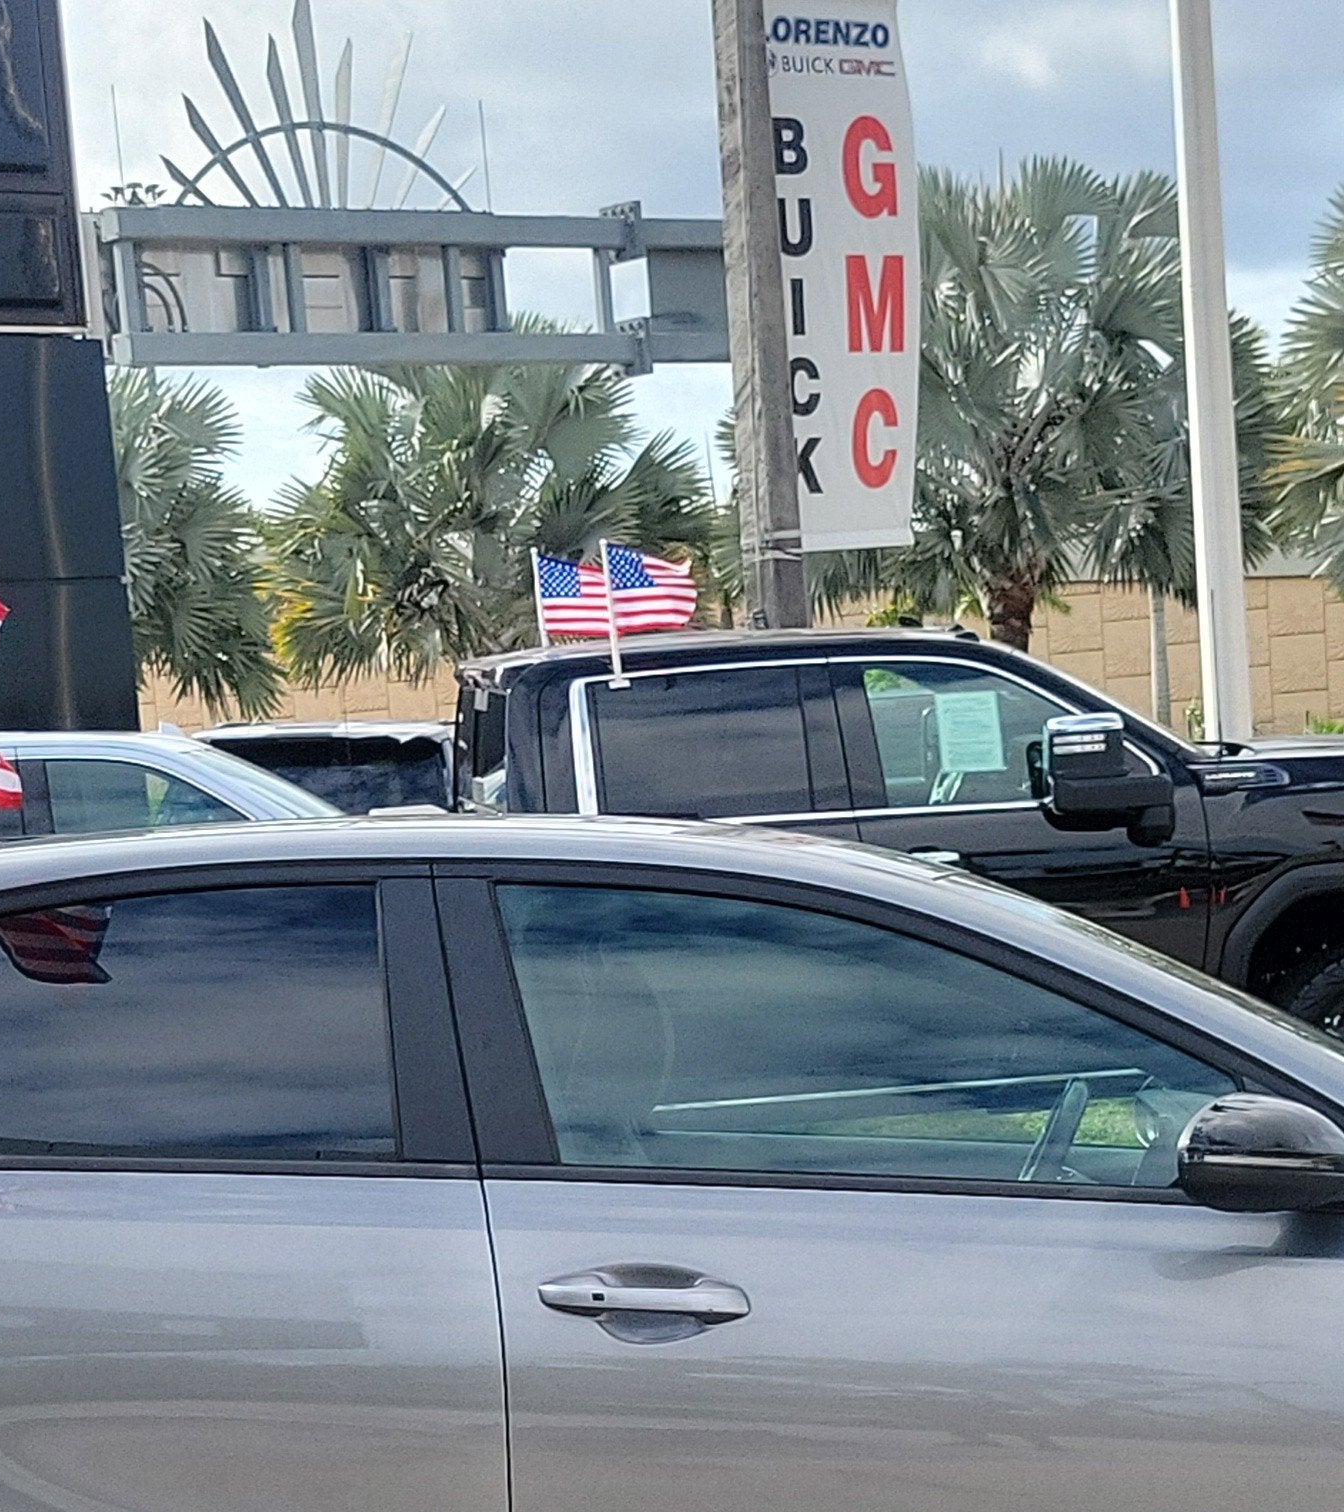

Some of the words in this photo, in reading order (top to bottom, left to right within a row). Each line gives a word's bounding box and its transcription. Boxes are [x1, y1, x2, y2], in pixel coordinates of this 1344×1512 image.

[765, 15, 890, 48] ORENZO
[781, 55, 835, 75] BUICK
[839, 58, 896, 77] GMC
[771, 116, 824, 494] BUICK
[842, 114, 905, 489] GMC
